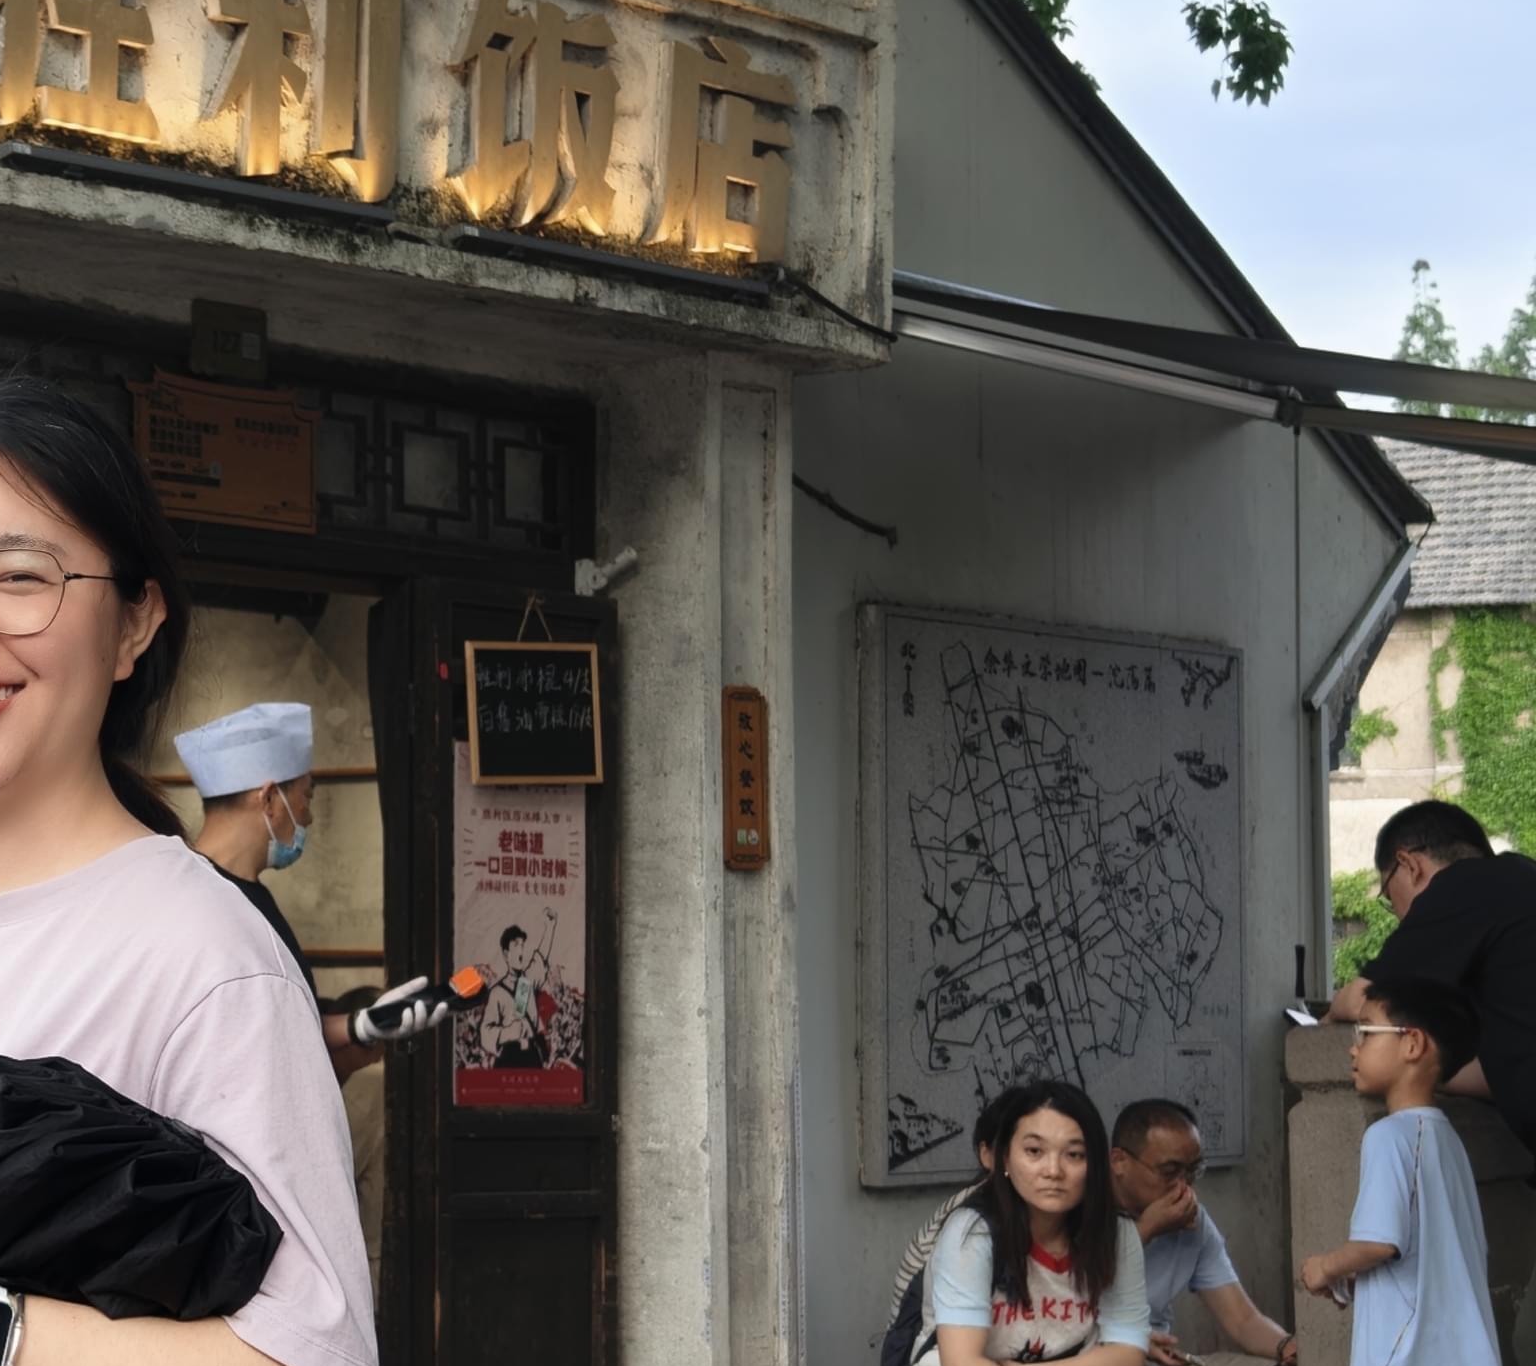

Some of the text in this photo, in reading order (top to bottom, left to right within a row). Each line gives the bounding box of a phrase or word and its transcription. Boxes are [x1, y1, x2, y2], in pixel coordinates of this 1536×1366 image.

[498, 829, 545, 855] 老味道
[473, 856, 568, 880] 一口回到小时候
[992, 1299, 1035, 1325] THE
